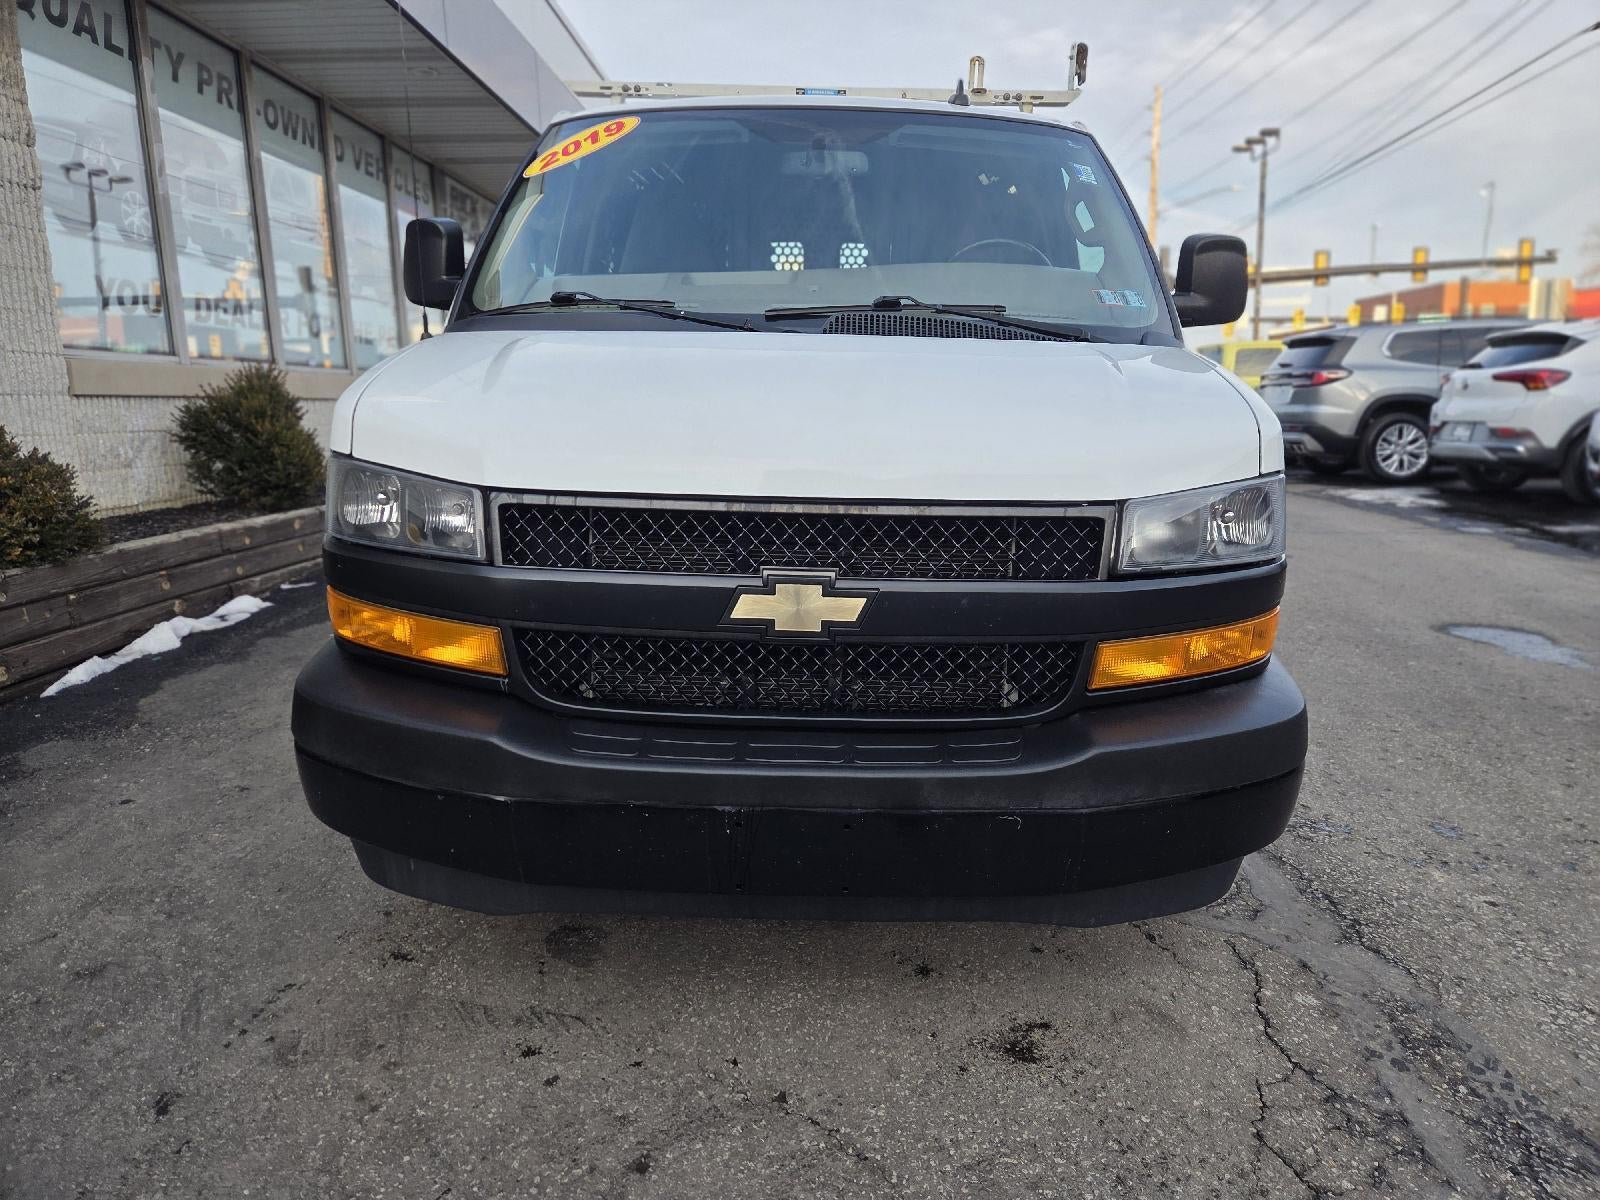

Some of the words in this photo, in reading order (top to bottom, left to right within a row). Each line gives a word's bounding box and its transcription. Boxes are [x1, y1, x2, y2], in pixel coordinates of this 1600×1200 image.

[17, 0, 185, 84] UALTY
[197, 62, 345, 163] PR-OWND
[352, 142, 430, 204] VEHCLES
[539, 121, 625, 171] 2019
[95, 277, 163, 315] YOU
[195, 294, 290, 334] DEALR
